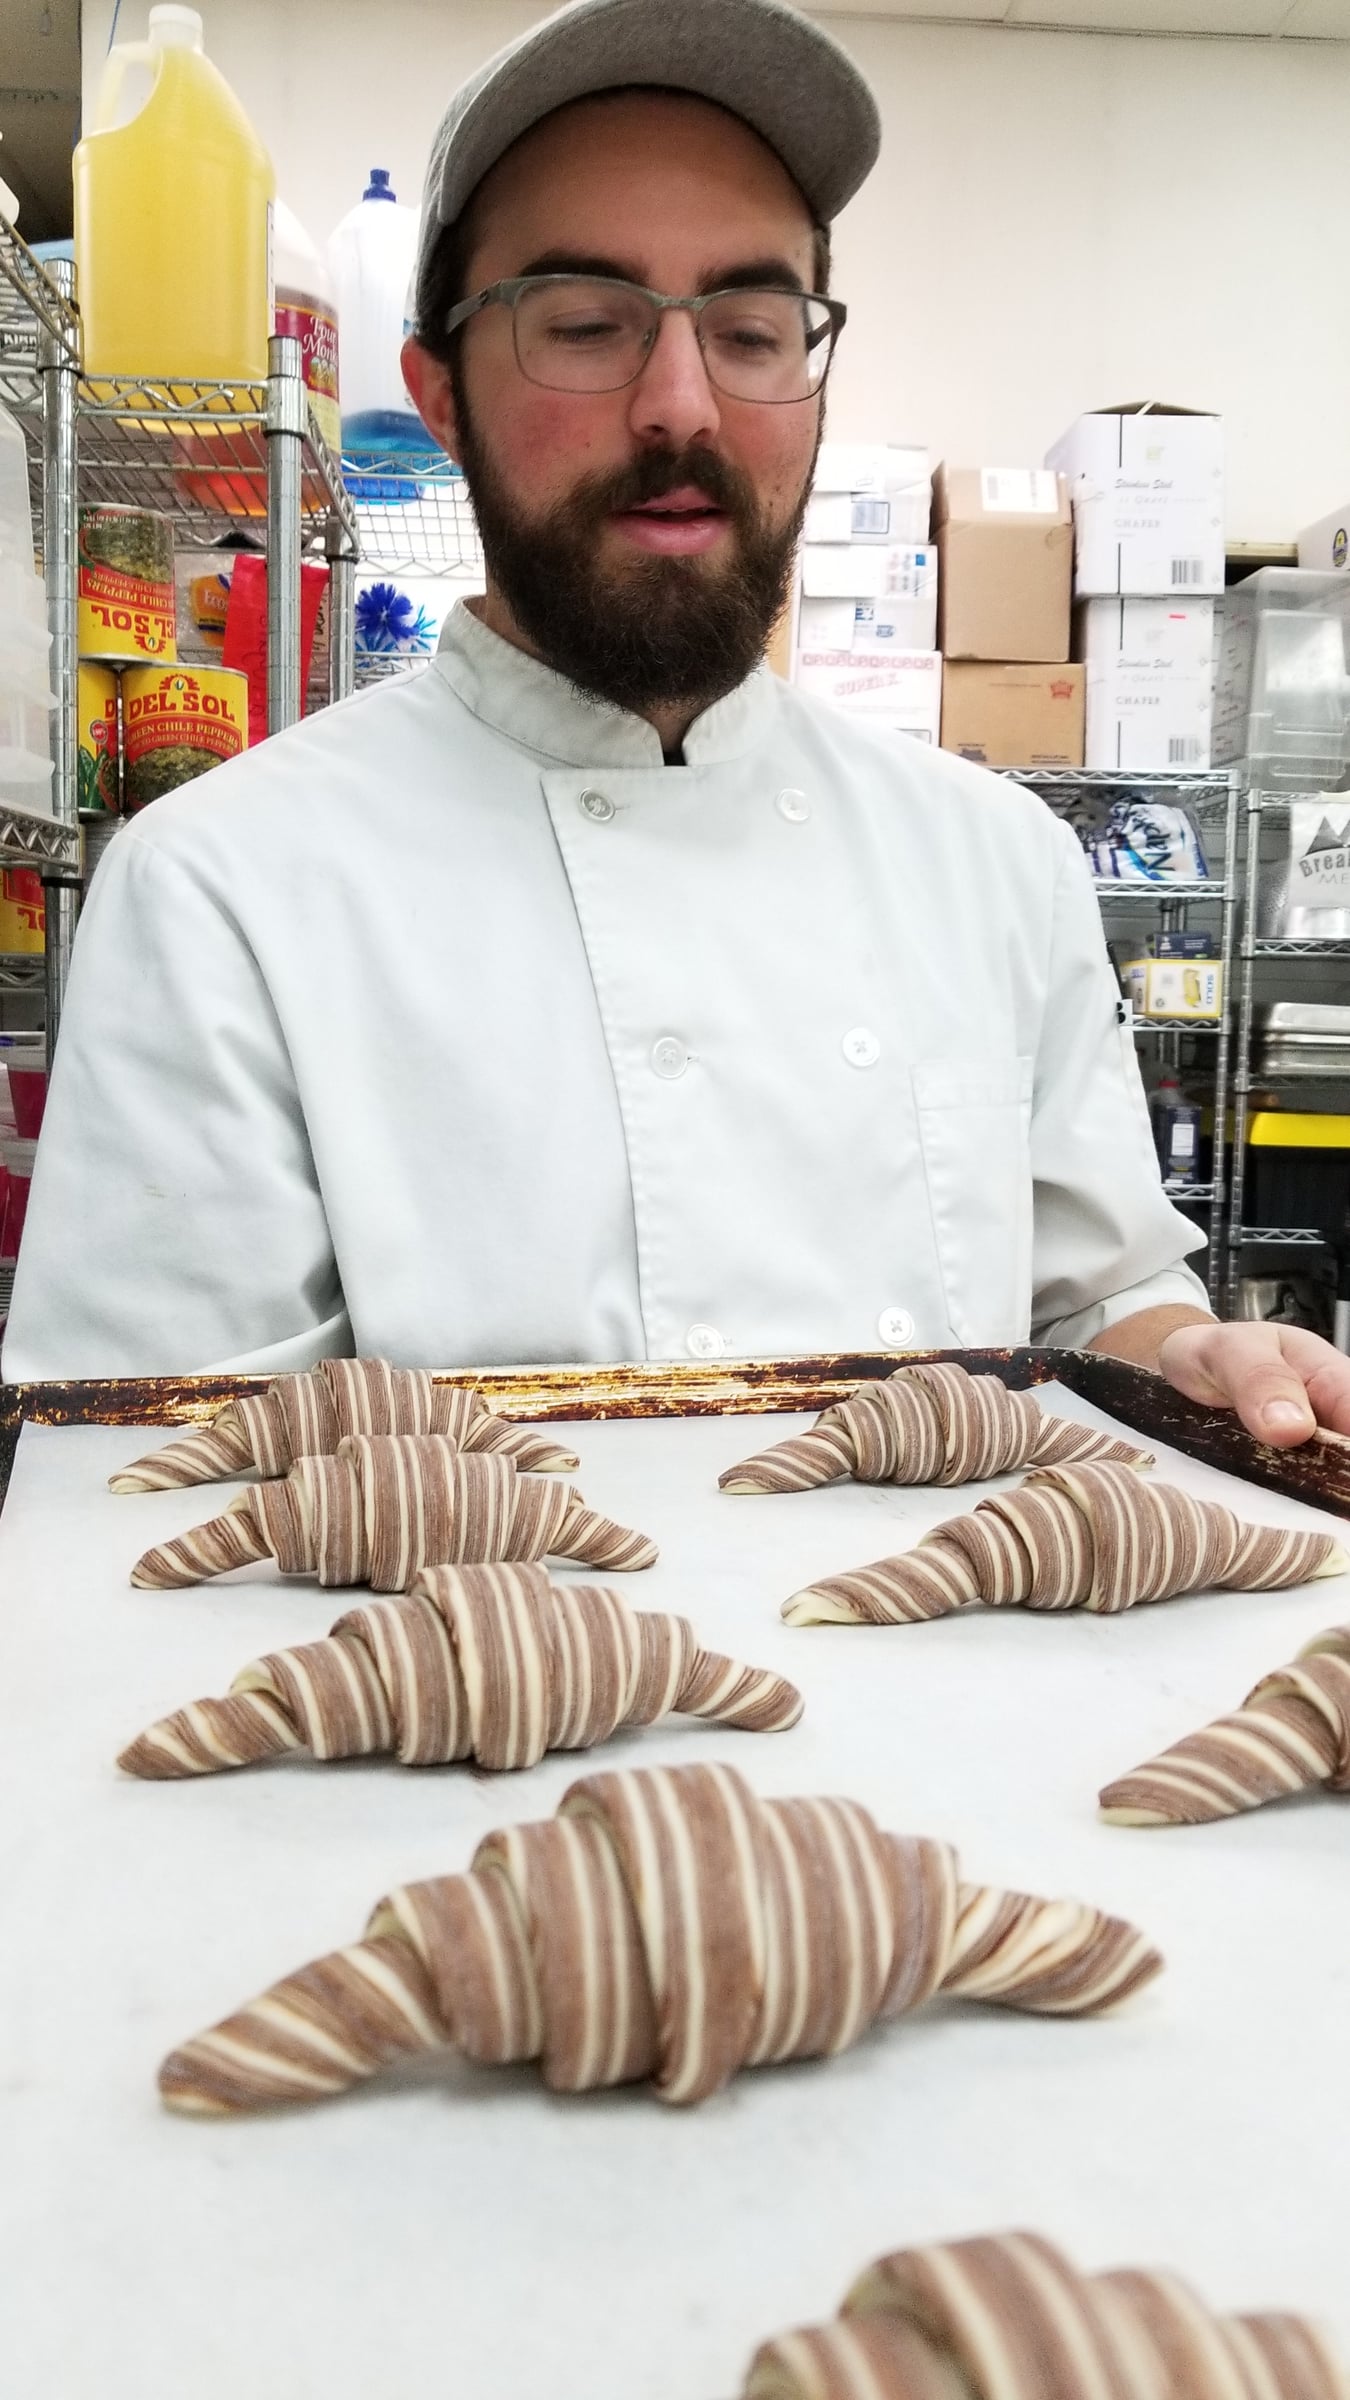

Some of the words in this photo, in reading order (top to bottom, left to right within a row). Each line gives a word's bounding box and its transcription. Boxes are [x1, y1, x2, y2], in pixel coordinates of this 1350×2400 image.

[86, 577, 138, 603] PEPPERS
[90, 604, 150, 634] SOL
[129, 691, 177, 720] DEL
[183, 691, 235, 723] SOL
[157, 721, 194, 732] CHILE
[196, 722, 239, 749] PEPPERS
